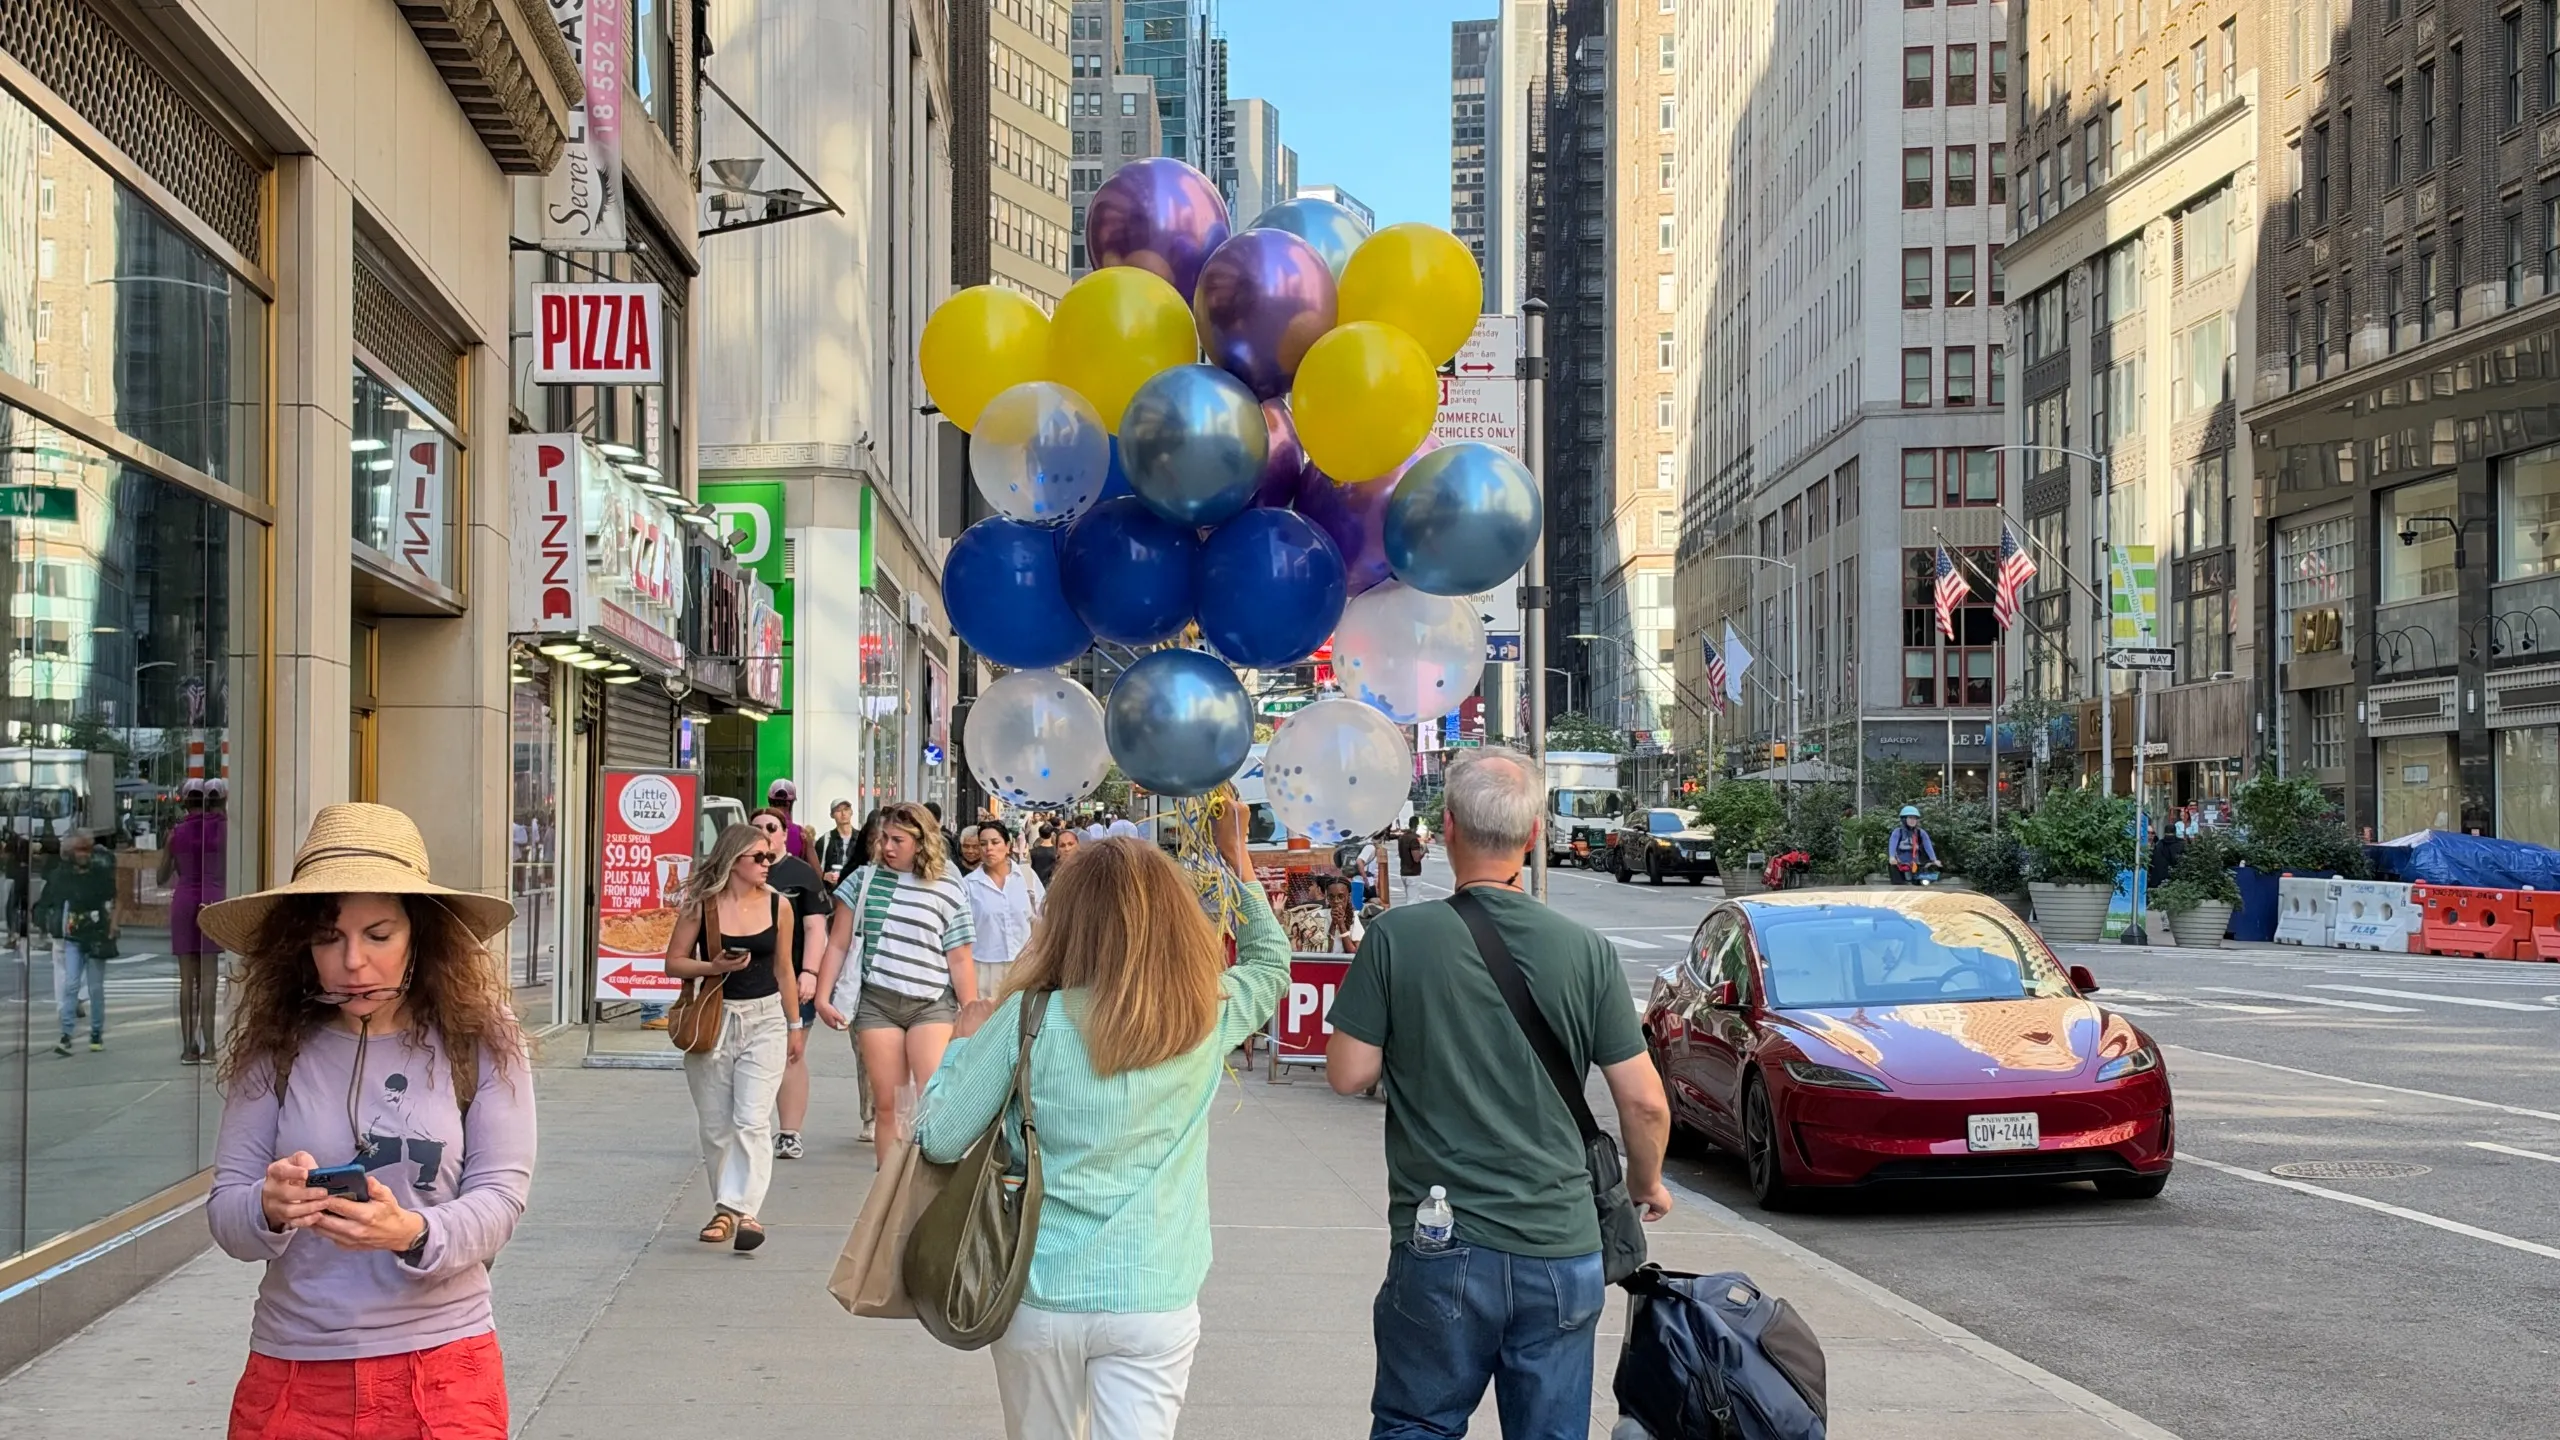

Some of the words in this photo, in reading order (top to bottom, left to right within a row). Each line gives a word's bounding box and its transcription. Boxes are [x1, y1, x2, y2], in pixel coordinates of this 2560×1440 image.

[549, 150, 591, 236] Secret
[542, 295, 651, 370] PIZZA
[1450, 388, 1481, 396] metered
[1450, 397, 1477, 405] parking
[1437, 412, 1505, 424] OMMERCIAL
[1487, 426, 1516, 438] ONLY
[538, 445, 572, 620] PIZZA
[2119, 552, 2145, 632] #GarmentDistric
[2117, 654, 2136, 663] ONE
[2149, 655, 2168, 664] WAY
[1880, 736, 1919, 744] BAKERY
[1951, 734, 1970, 746] LE
[633, 788, 668, 801] Little
[633, 800, 667, 810] ITALY
[633, 811, 666, 819] PIZZA
[606, 833, 611, 843] 2
[611, 834, 628, 843] SLICE
[628, 834, 652, 844] SPECIAL
[604, 842, 652, 869] $9.99
[604, 870, 629, 884] PLUS
[631, 871, 651, 885] TAX
[603, 884, 627, 896] FROM
[629, 885, 650, 897] 10AM
[611, 896, 623, 908] TO
[623, 897, 641, 908] 5PM
